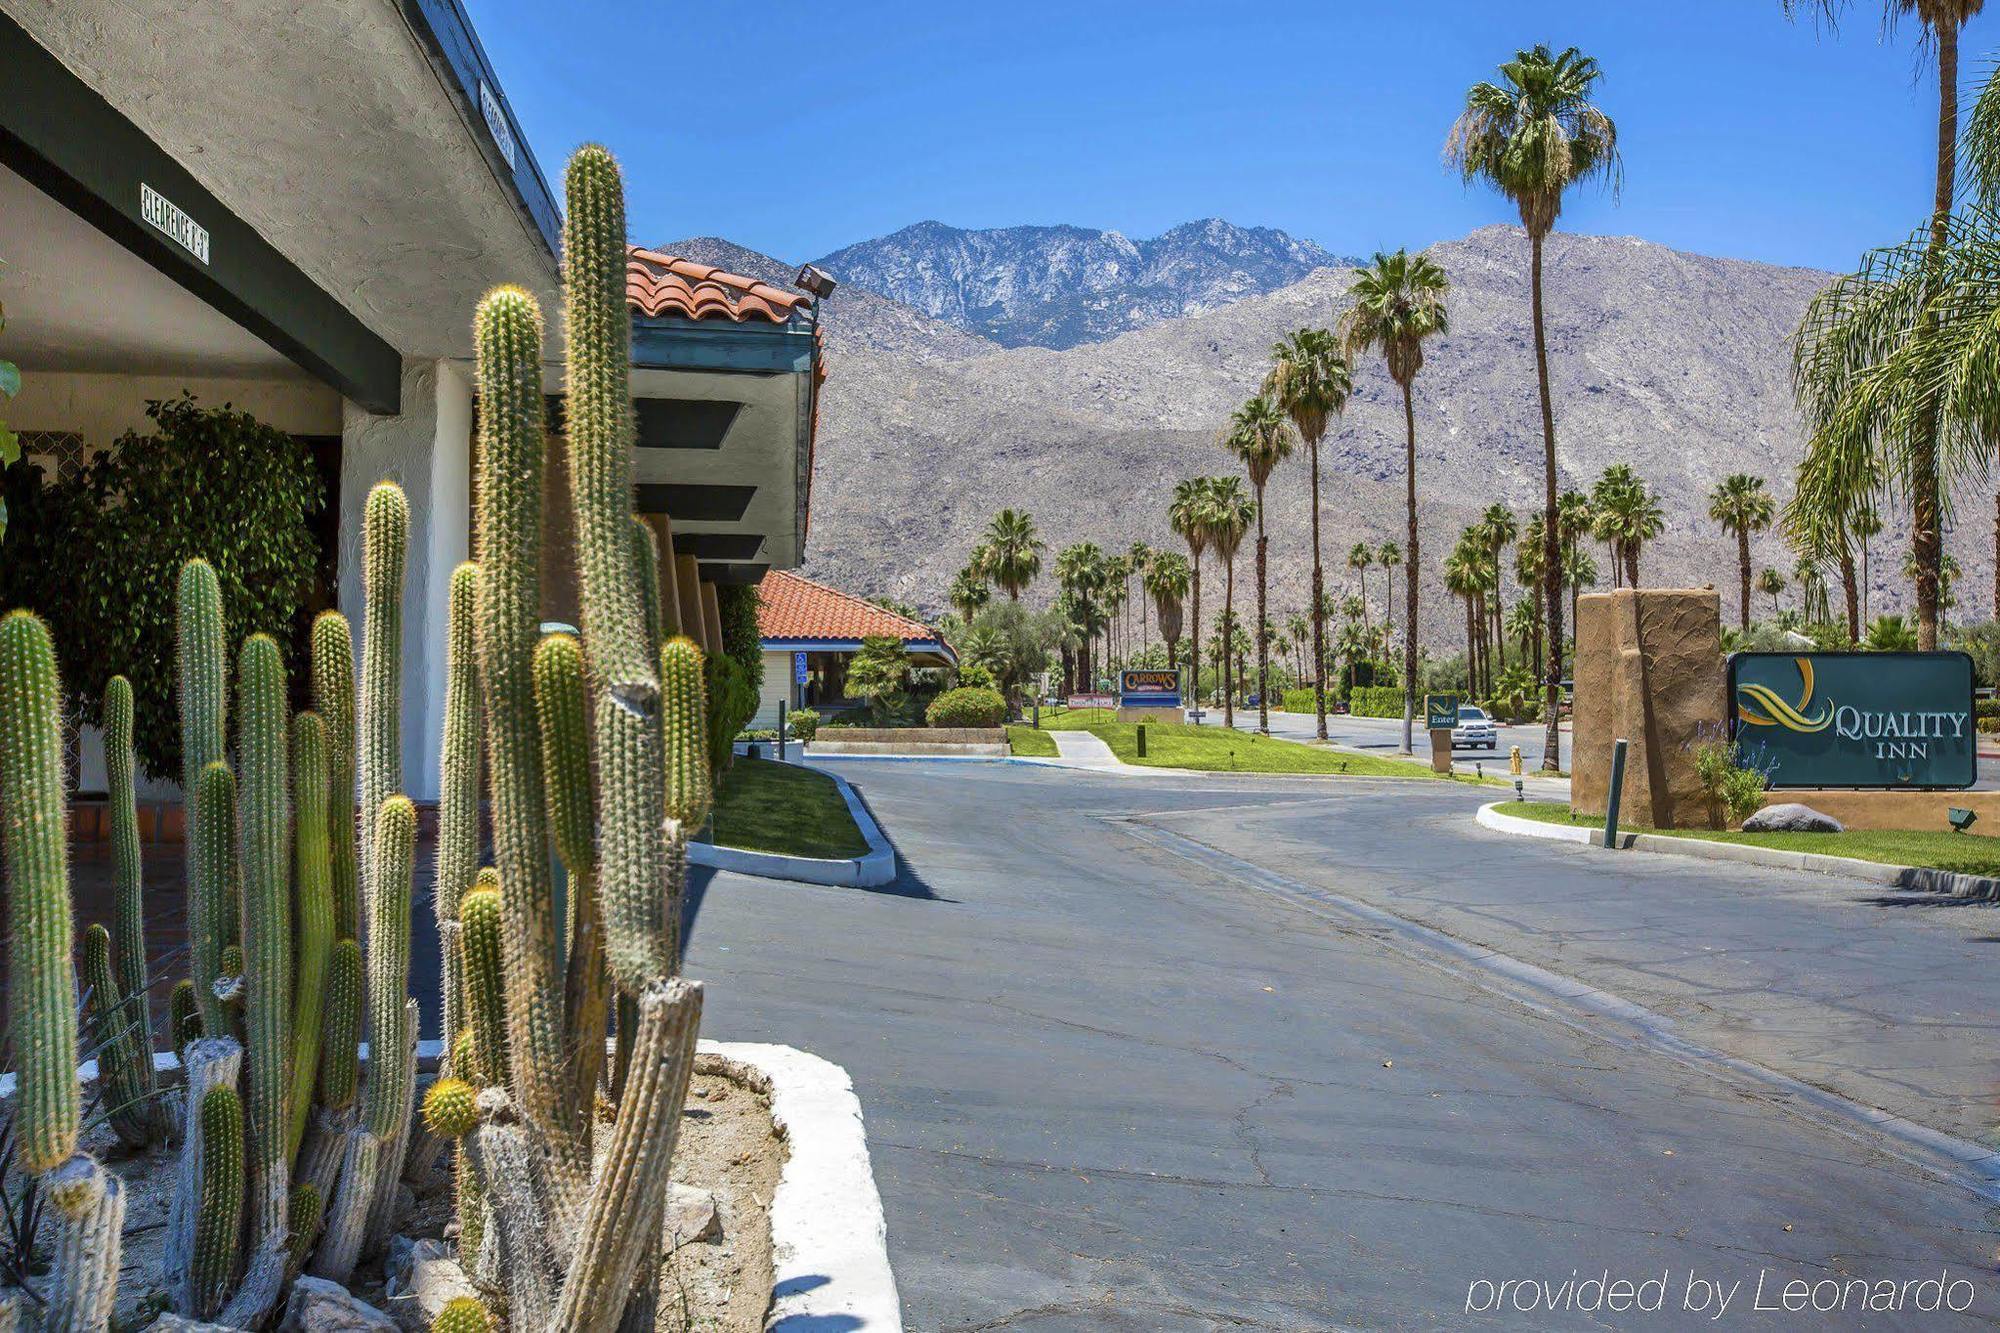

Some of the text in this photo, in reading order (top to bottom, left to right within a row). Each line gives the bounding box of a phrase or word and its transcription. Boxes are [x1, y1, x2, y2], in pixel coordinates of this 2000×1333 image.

[143, 188, 190, 247] CLEARENCE
[1125, 672, 1176, 690] CARROWS
[1432, 715, 1455, 724] Enter
[1835, 705, 1968, 740] QUALITY
[1875, 742, 1928, 759] INN
